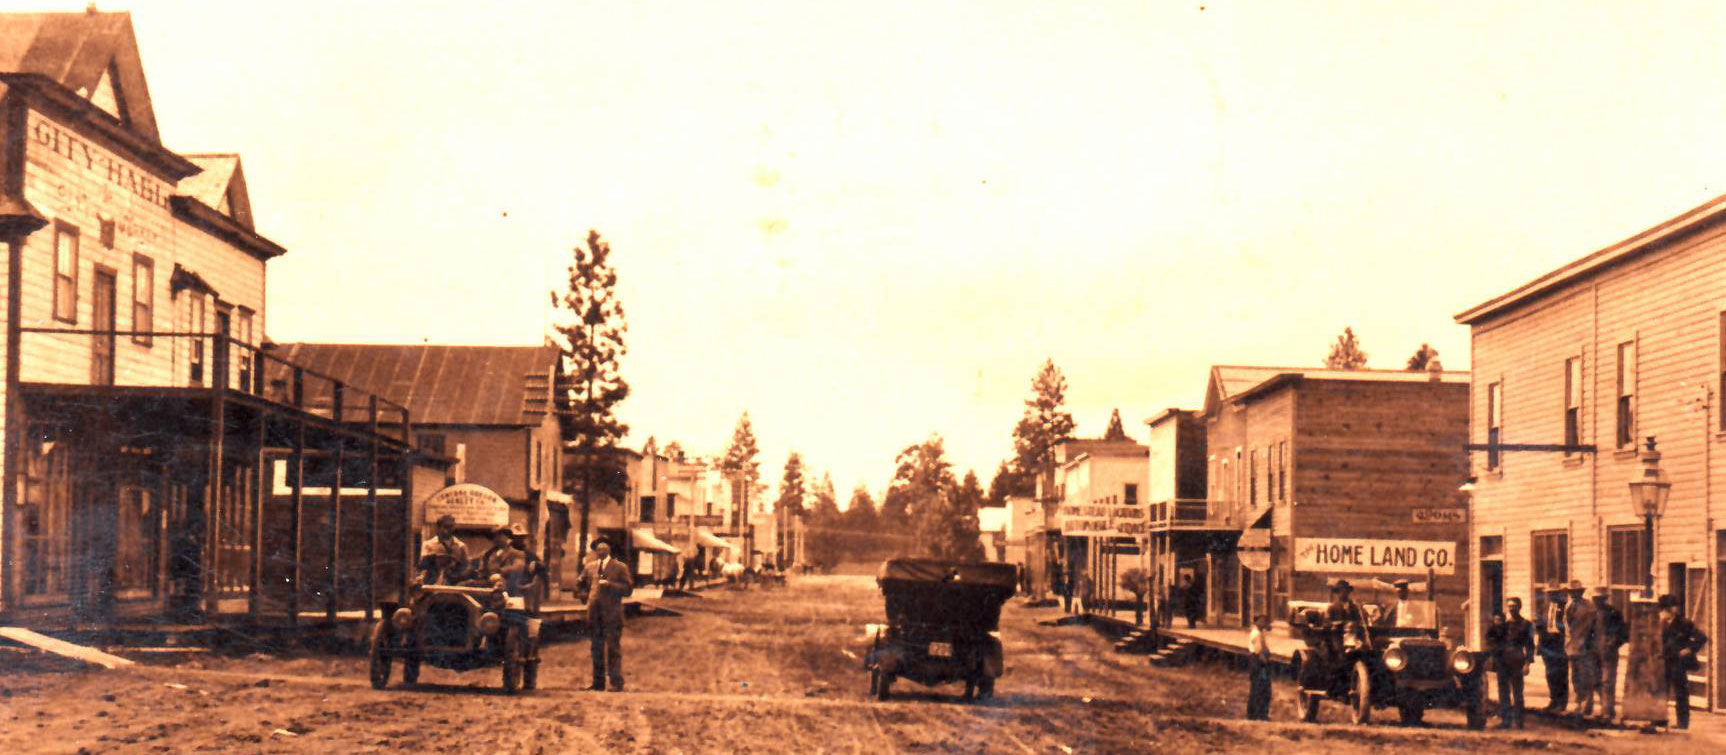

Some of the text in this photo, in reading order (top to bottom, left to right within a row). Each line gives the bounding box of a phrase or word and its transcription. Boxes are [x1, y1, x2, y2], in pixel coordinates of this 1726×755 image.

[34, 120, 97, 170] CITY
[1315, 543, 1363, 565] HOME
[1370, 547, 1417, 567] LAND
[1423, 548, 1453, 568] CO.
